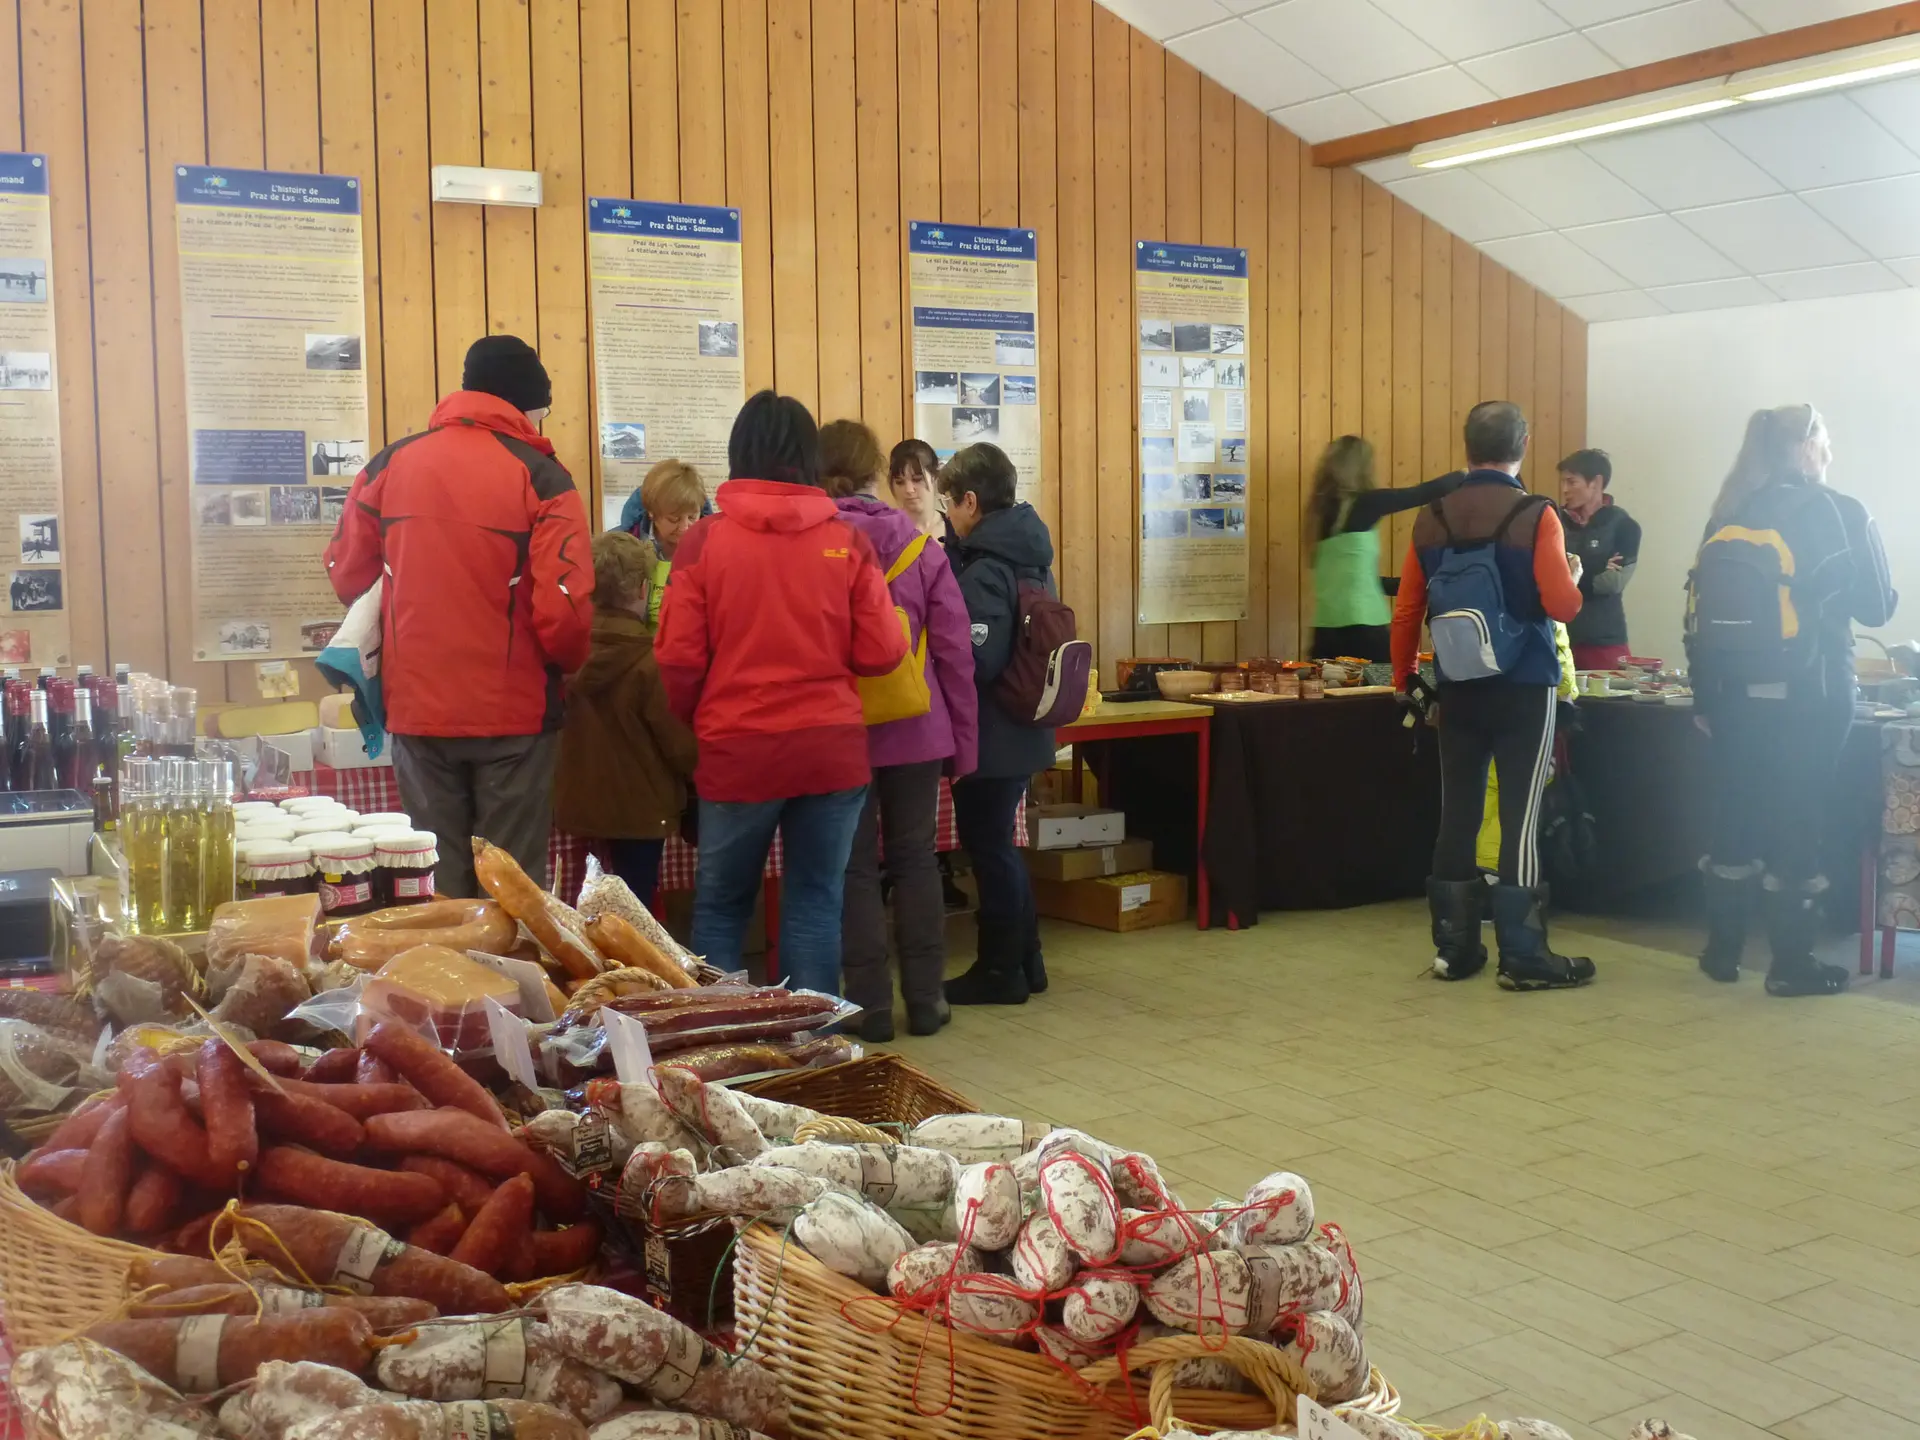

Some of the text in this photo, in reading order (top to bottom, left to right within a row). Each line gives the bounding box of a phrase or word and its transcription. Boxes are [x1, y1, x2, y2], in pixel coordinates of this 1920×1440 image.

[271, 184, 306, 195] L'histoire
[250, 191, 267, 201] Praz
[270, 193, 279, 201] de
[282, 194, 295, 202] Lys
[303, 195, 340, 205] Sommand
[668, 215, 696, 224] L'histoire
[693, 225, 724, 234] Sommand
[974, 236, 999, 244] L'histoire
[1310, 1408, 1329, 1431] 5 €
